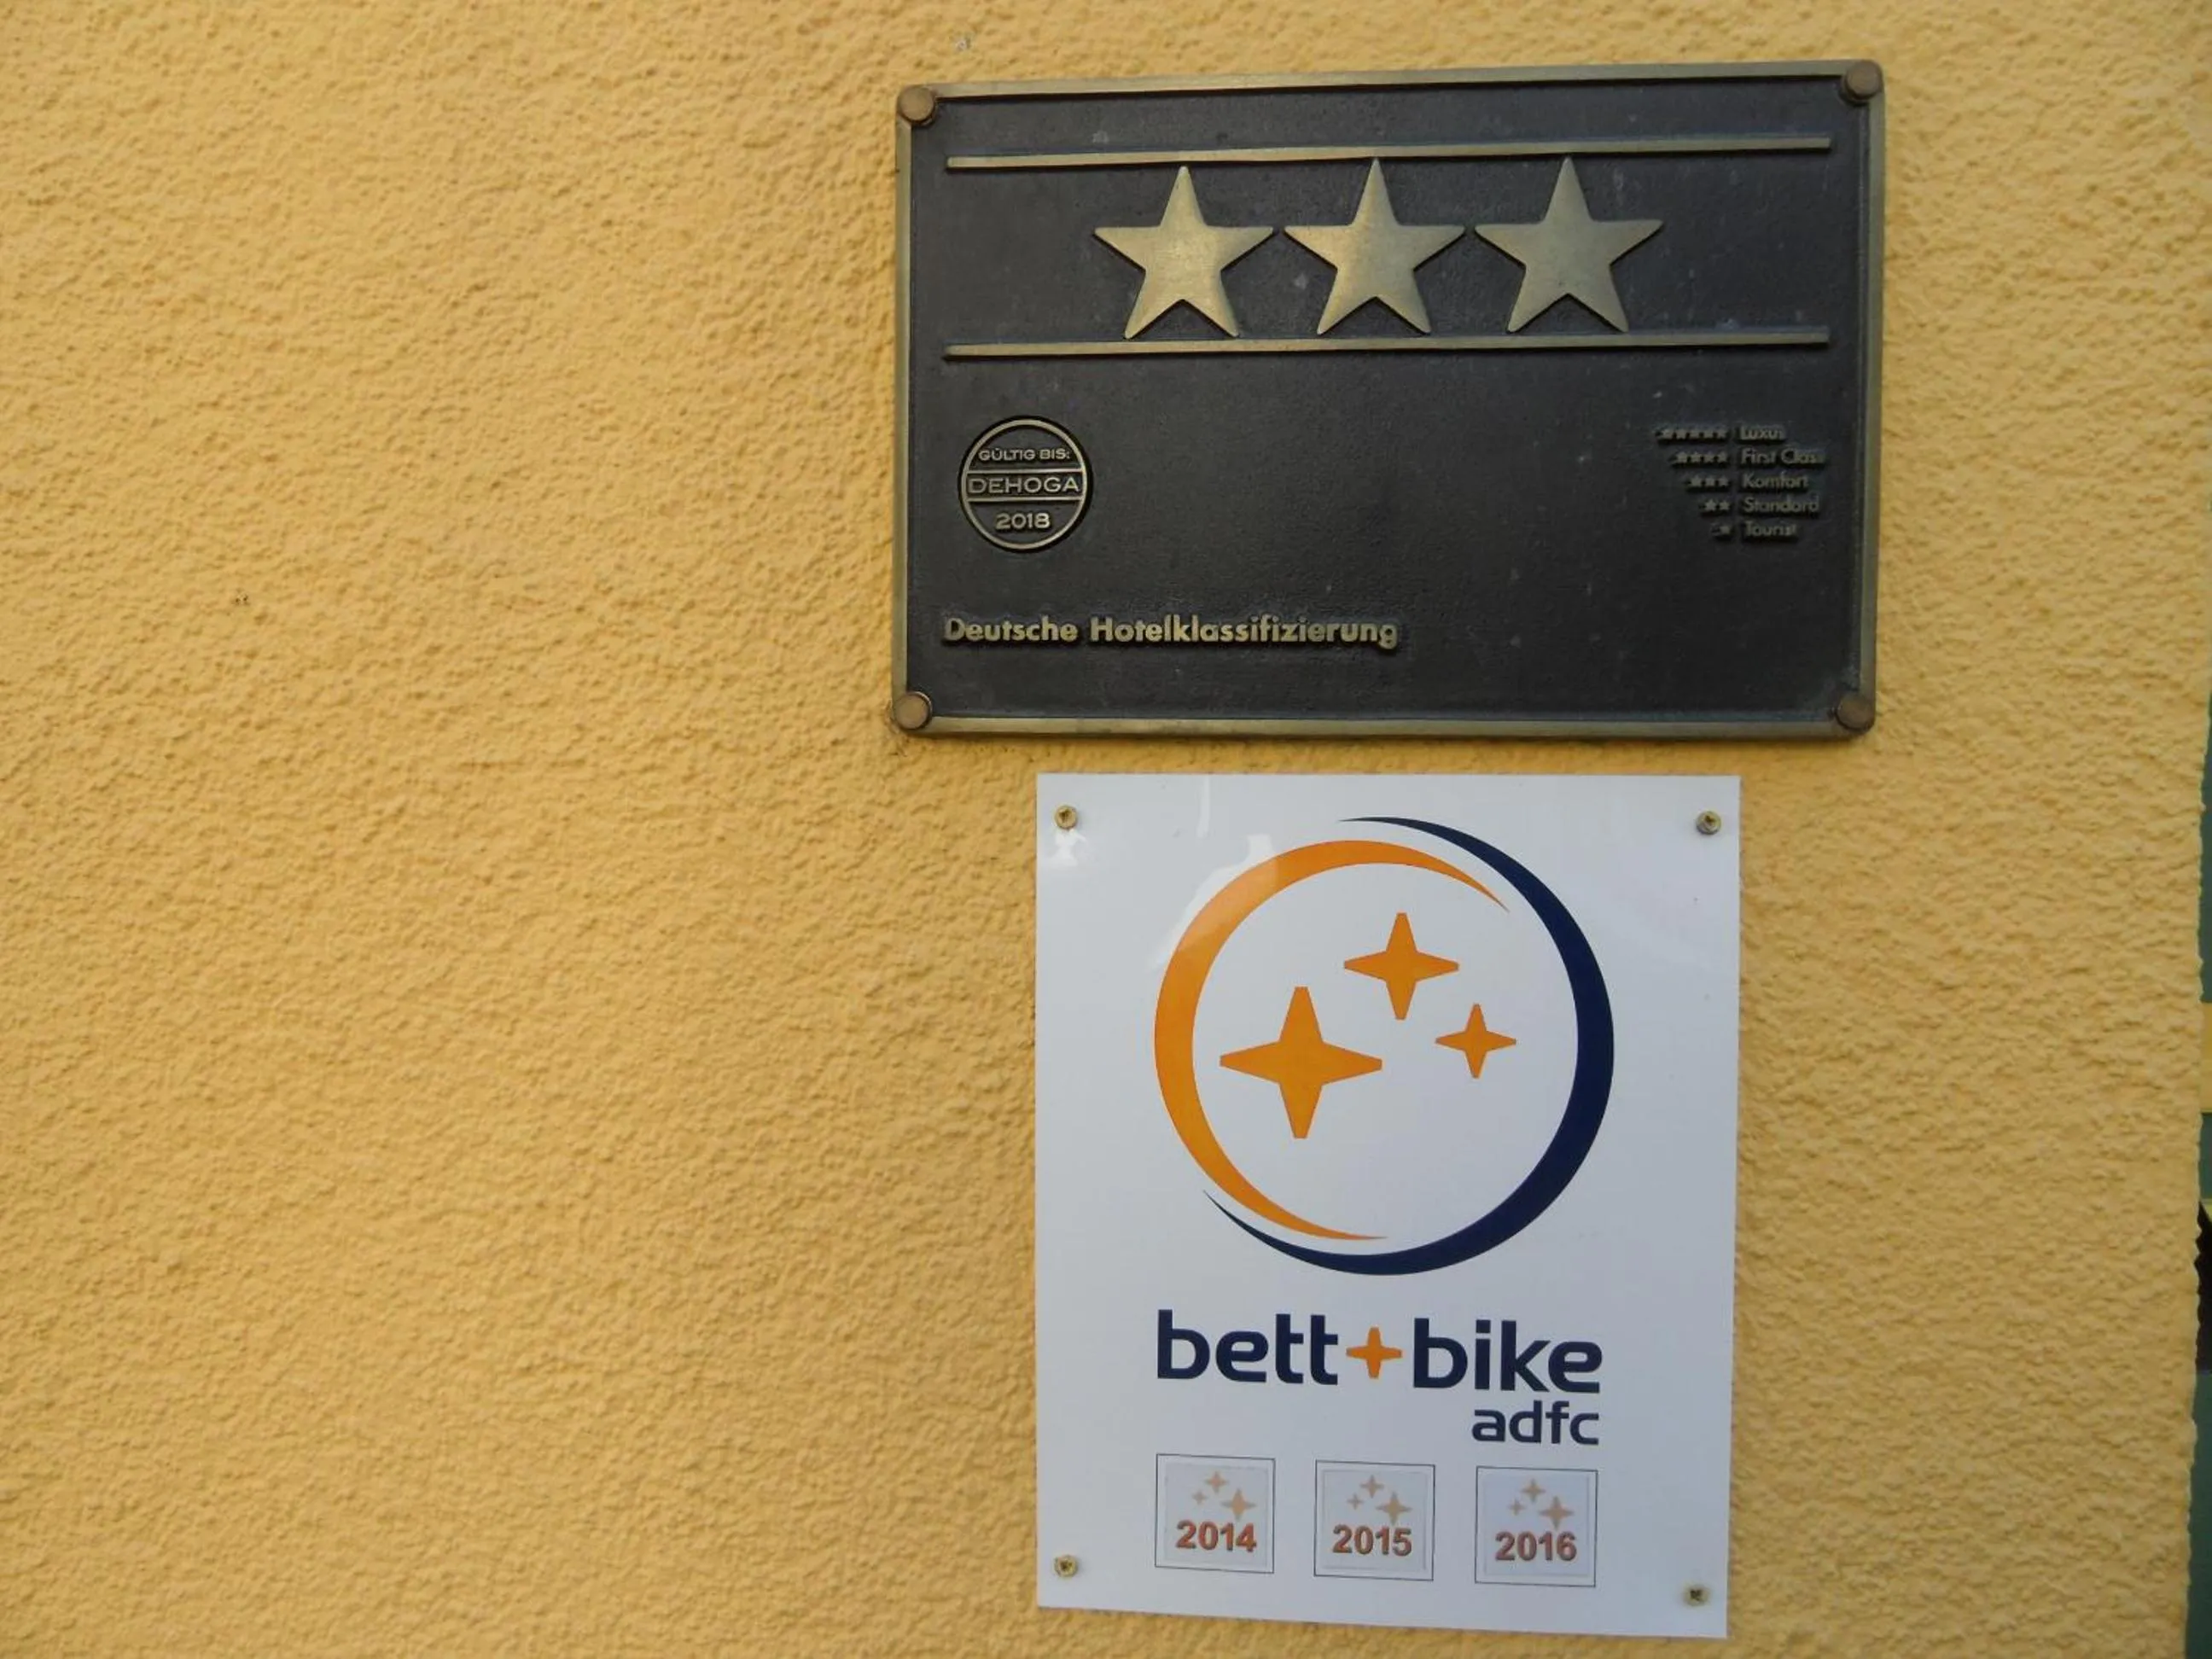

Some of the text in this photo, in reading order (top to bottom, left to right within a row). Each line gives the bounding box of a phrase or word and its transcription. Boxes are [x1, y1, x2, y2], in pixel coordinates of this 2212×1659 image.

[978, 448, 1071, 461] GÜLTIG BIS:
[1741, 447, 1776, 464] First
[968, 477, 1080, 494] DEHOGA
[1743, 471, 1809, 488] Komfort
[1743, 495, 1819, 513] Standard
[995, 512, 1051, 530] 2018
[1745, 521, 1797, 537] Tourist
[945, 614, 1399, 649] Deutsche Hotelklassifizierung
[1471, 1400, 1599, 1446] adfc
[1175, 1519, 1258, 1553] 2014
[1332, 1524, 1412, 1557] 2015
[1494, 1531, 1578, 1562] 2016
